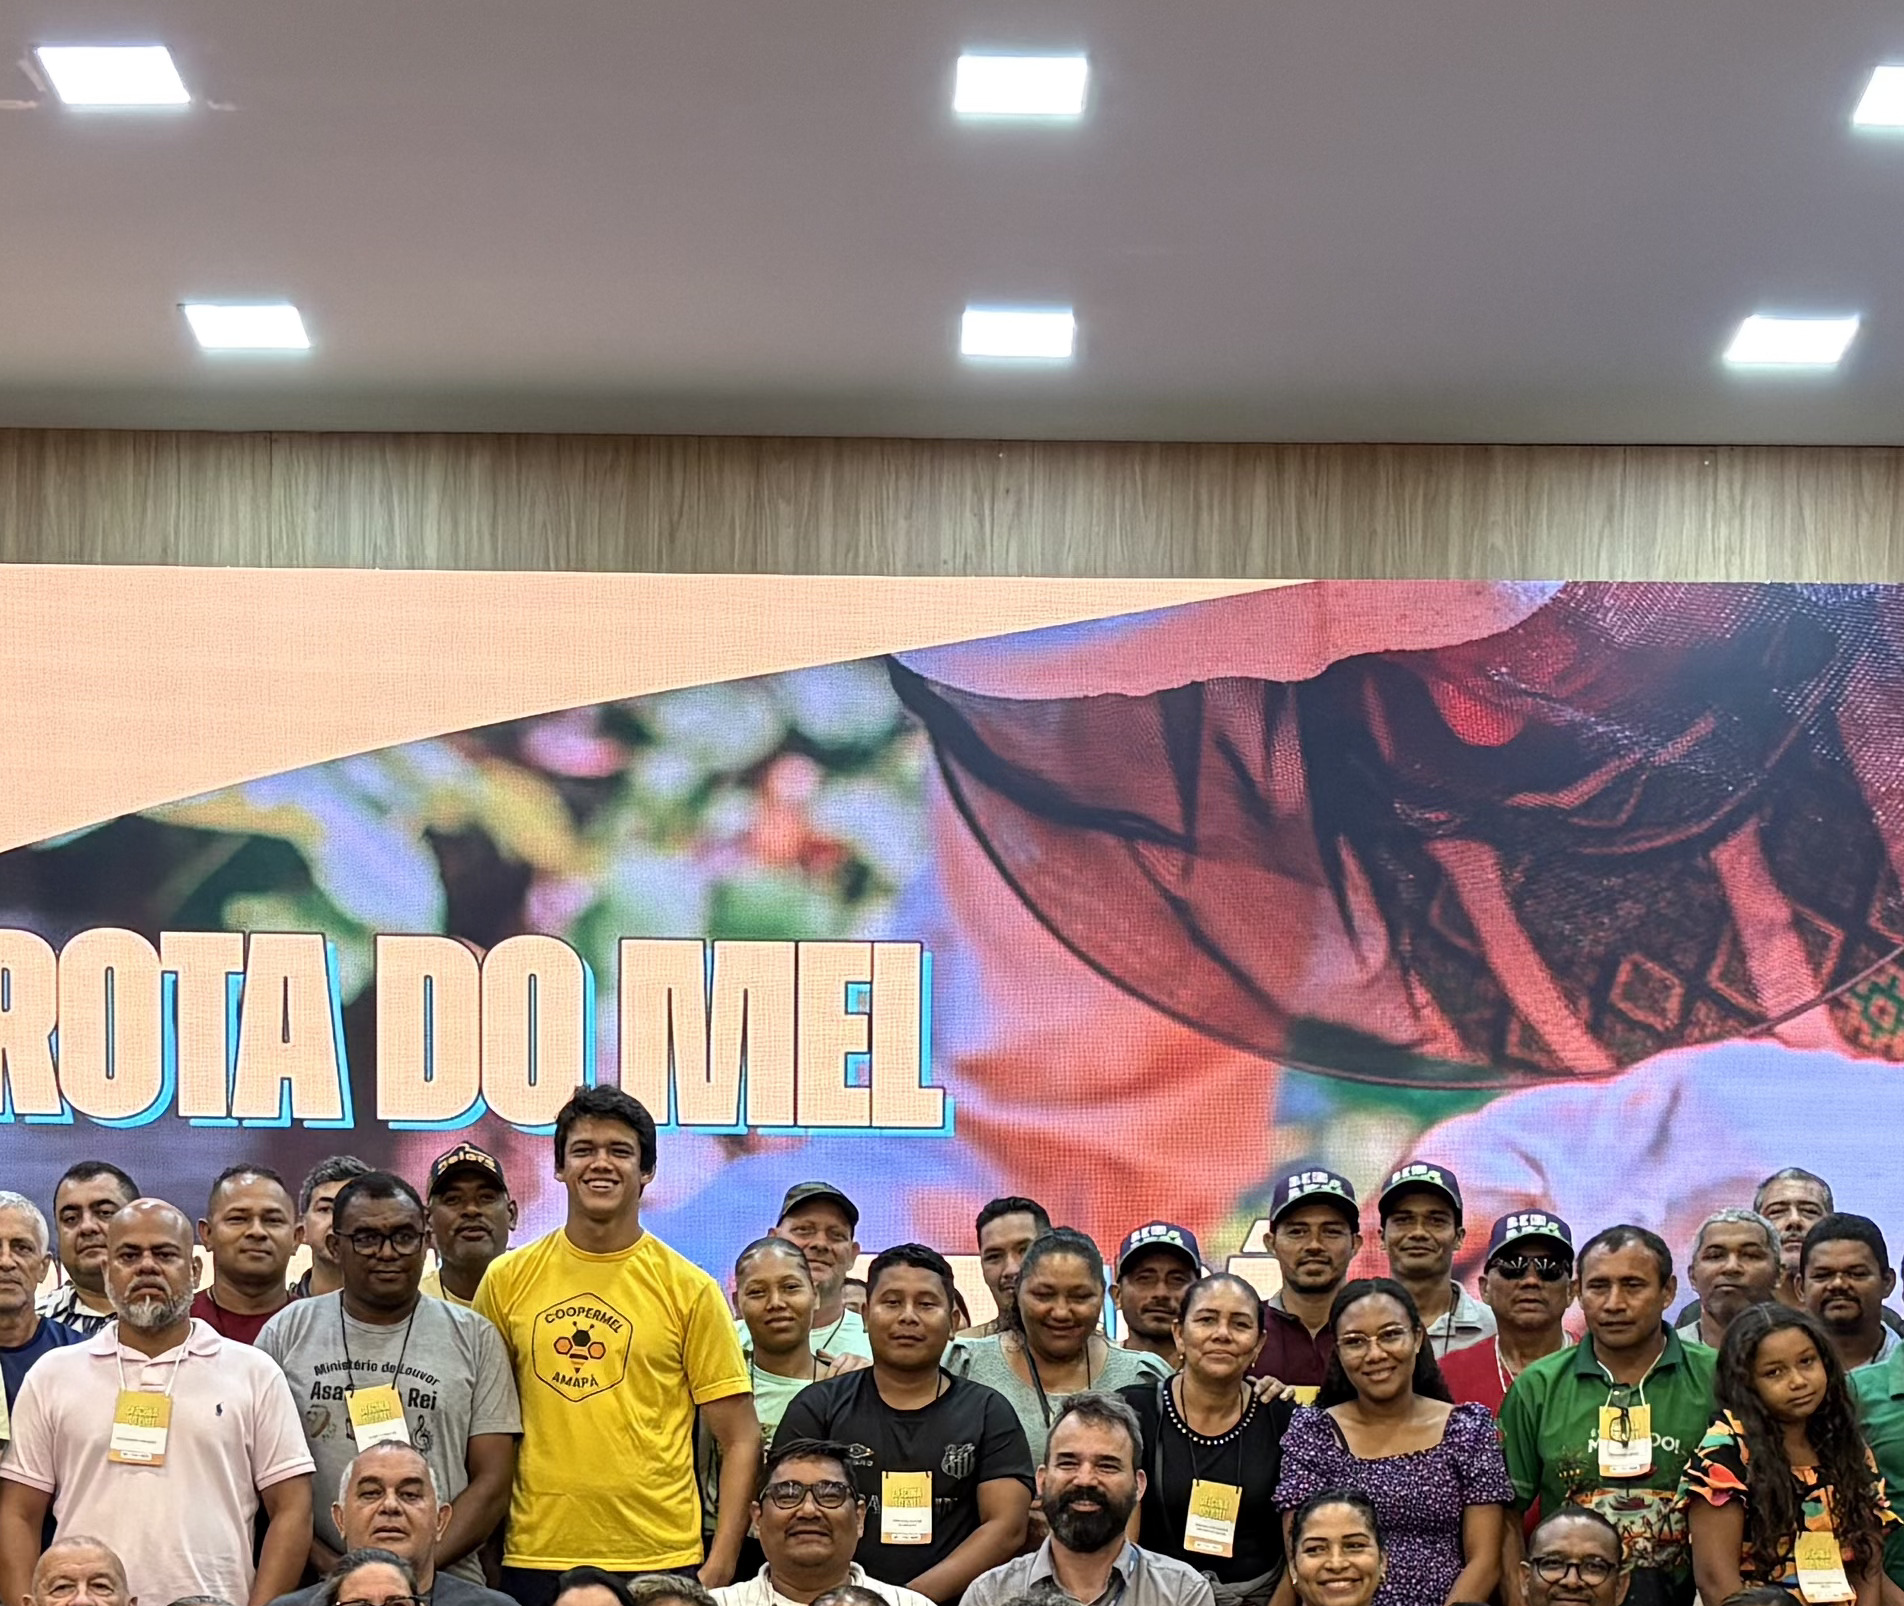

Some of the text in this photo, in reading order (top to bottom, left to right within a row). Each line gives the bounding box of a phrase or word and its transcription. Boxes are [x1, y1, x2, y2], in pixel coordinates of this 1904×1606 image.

[376, 932, 595, 1133] DO
[618, 937, 953, 1137] MEL
[544, 1306, 624, 1334] COOPERMEL
[314, 1359, 378, 1376] Ministério
[310, 1381, 438, 1411] Asa Rei
